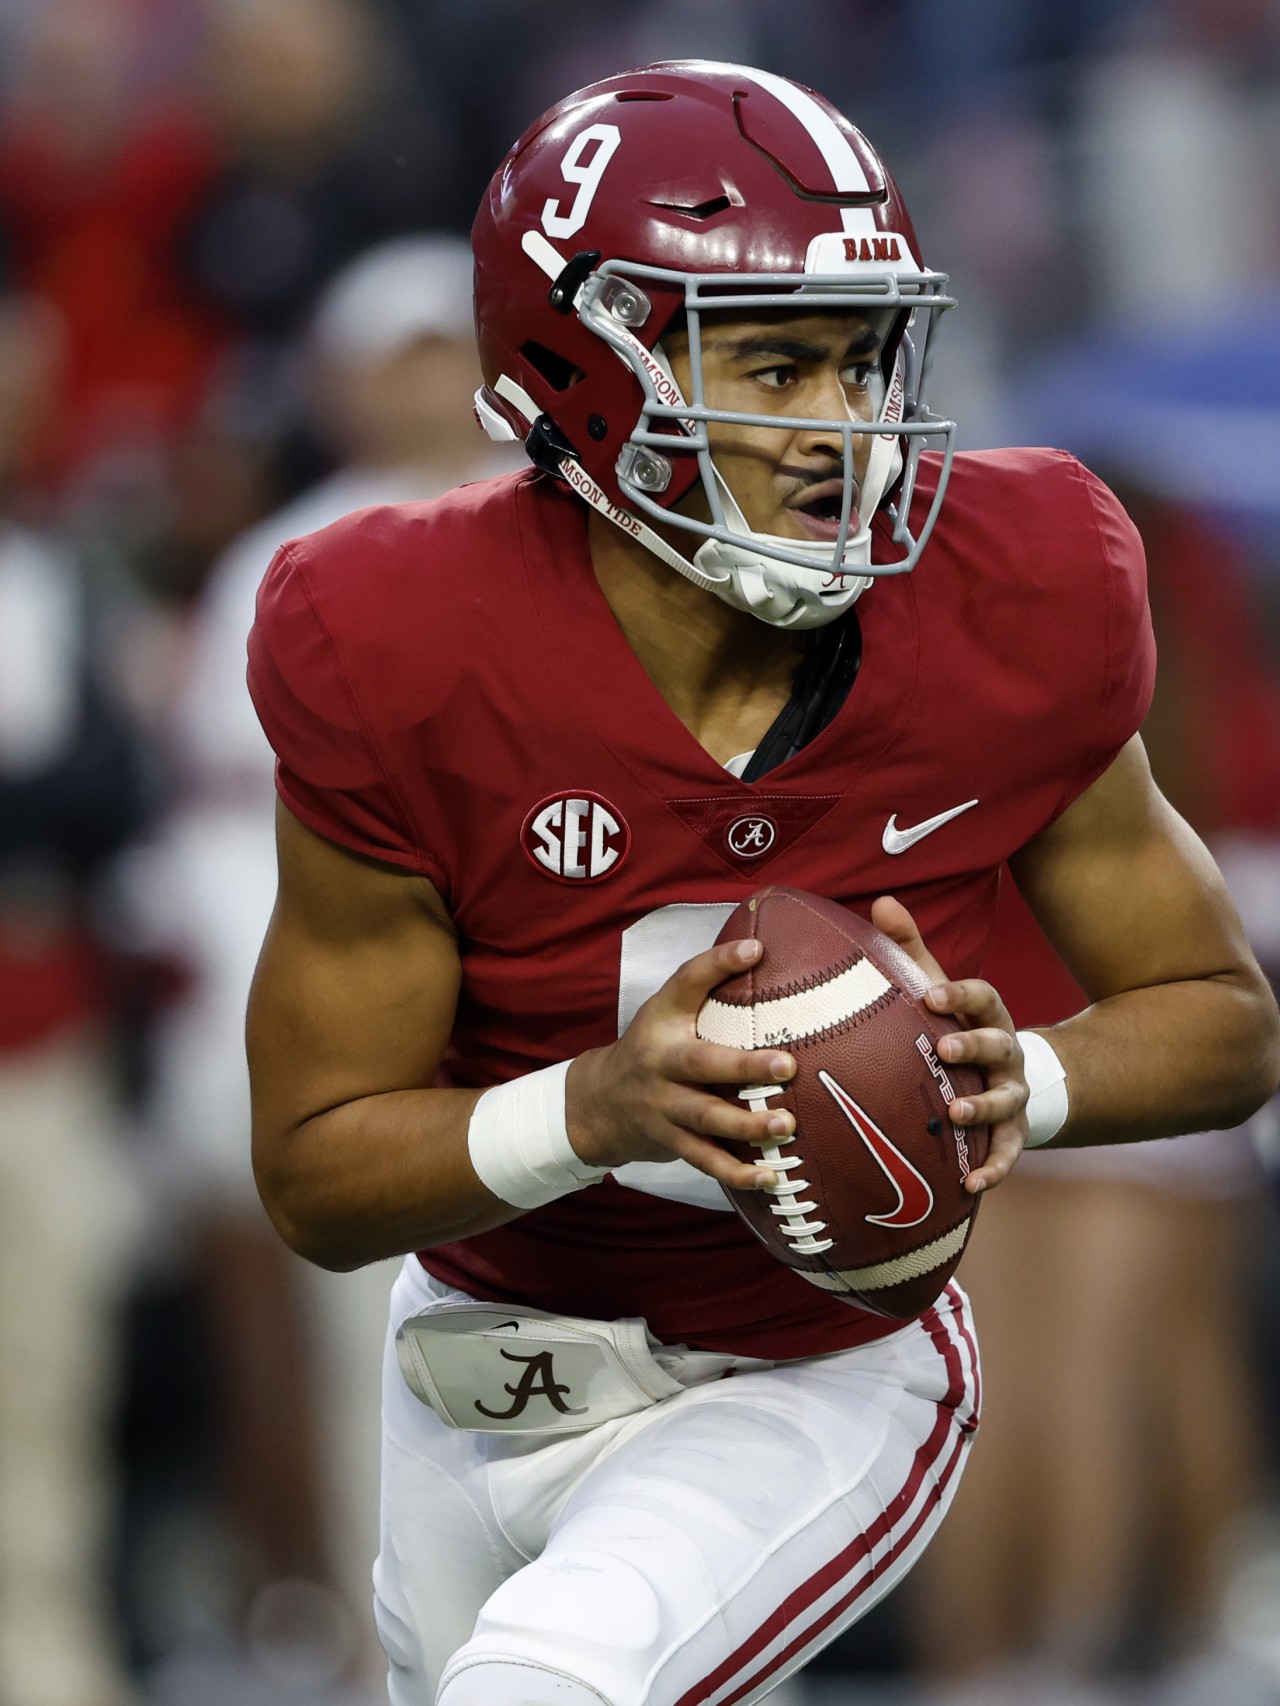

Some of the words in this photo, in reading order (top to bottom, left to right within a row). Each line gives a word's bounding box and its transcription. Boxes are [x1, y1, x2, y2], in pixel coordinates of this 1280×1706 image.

[541, 123, 621, 239] 9
[843, 238, 902, 261] BAMA
[606, 500, 642, 537] TIDE
[531, 798, 619, 879] SEC
[734, 822, 764, 849] A
[915, 1033, 956, 1106] ELITE
[953, 1123, 970, 1184] VAPO
[475, 1347, 590, 1420] A
